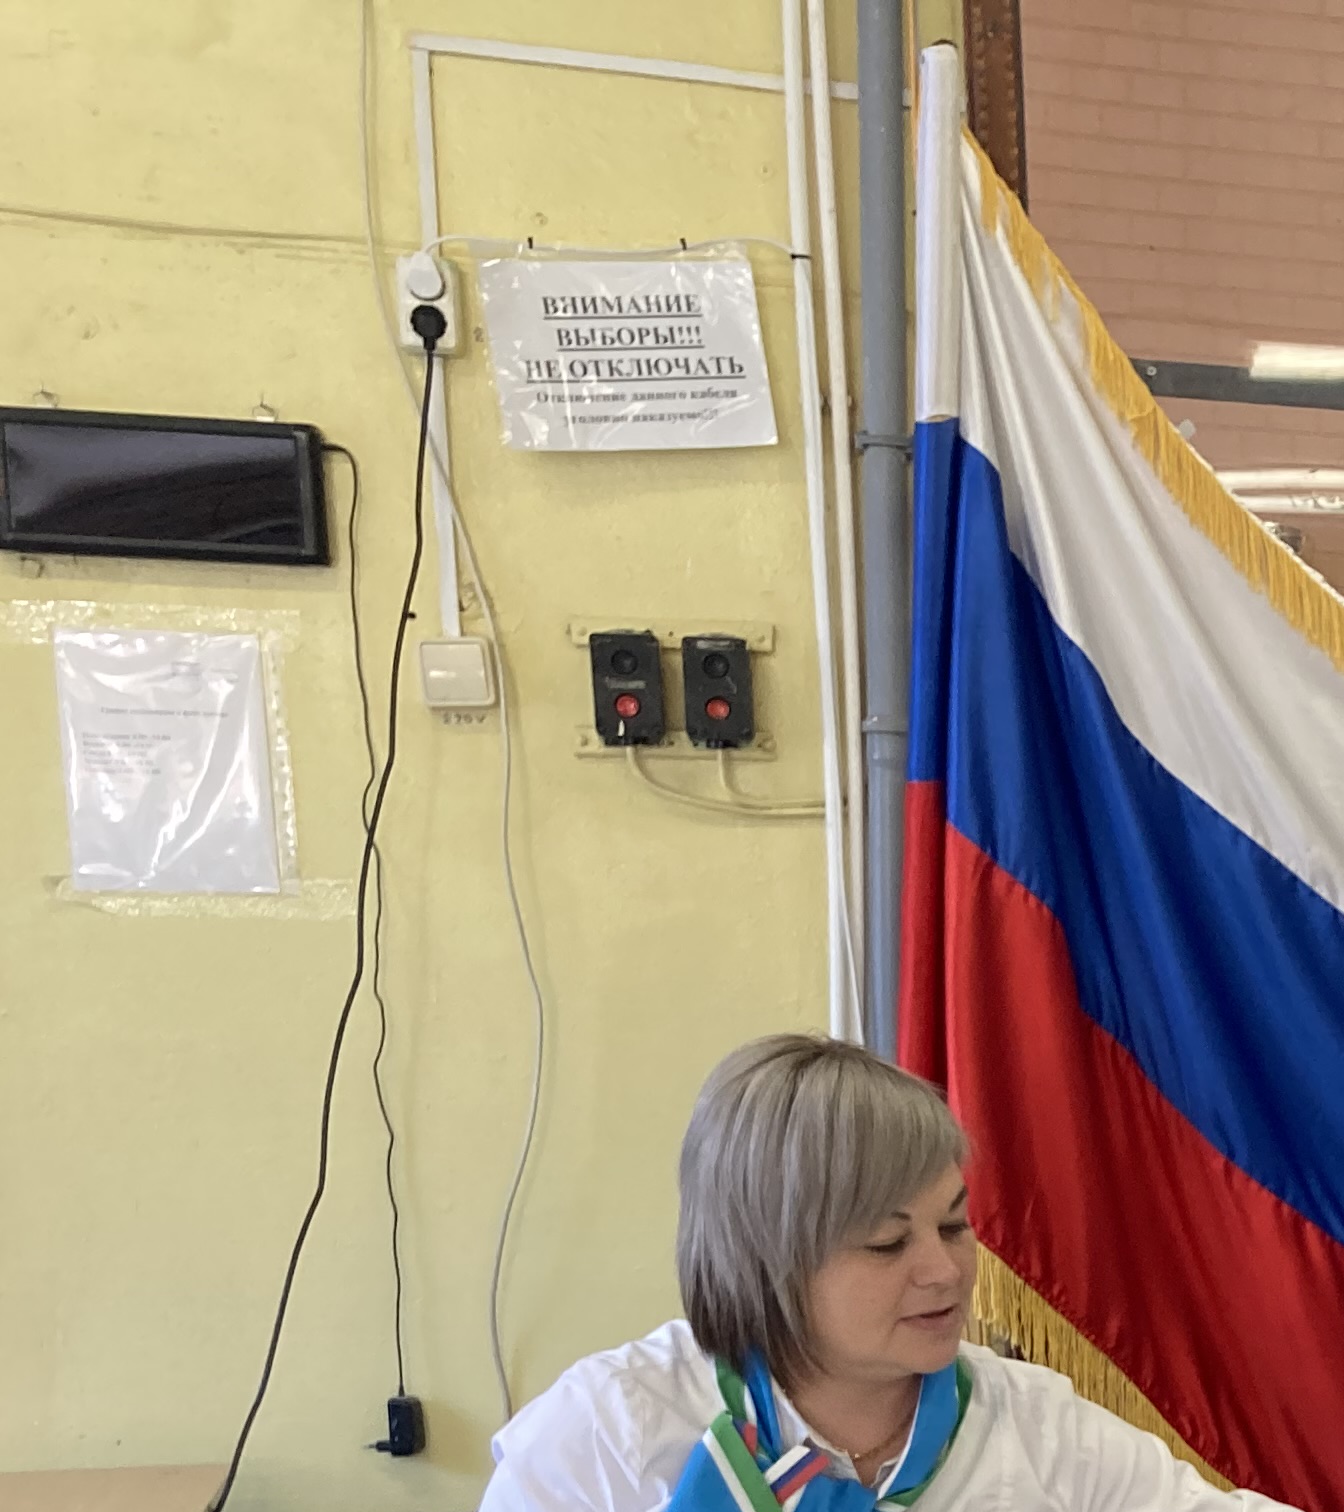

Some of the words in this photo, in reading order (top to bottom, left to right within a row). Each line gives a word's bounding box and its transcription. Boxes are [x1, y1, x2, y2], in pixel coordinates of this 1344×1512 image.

[542, 294, 703, 316] ВНИМАНИЕ
[556, 325, 703, 348] ВЫБОРЫ!!!
[525, 359, 563, 379] НЕ
[568, 355, 745, 379] ОТКЛЮЧАТЬ
